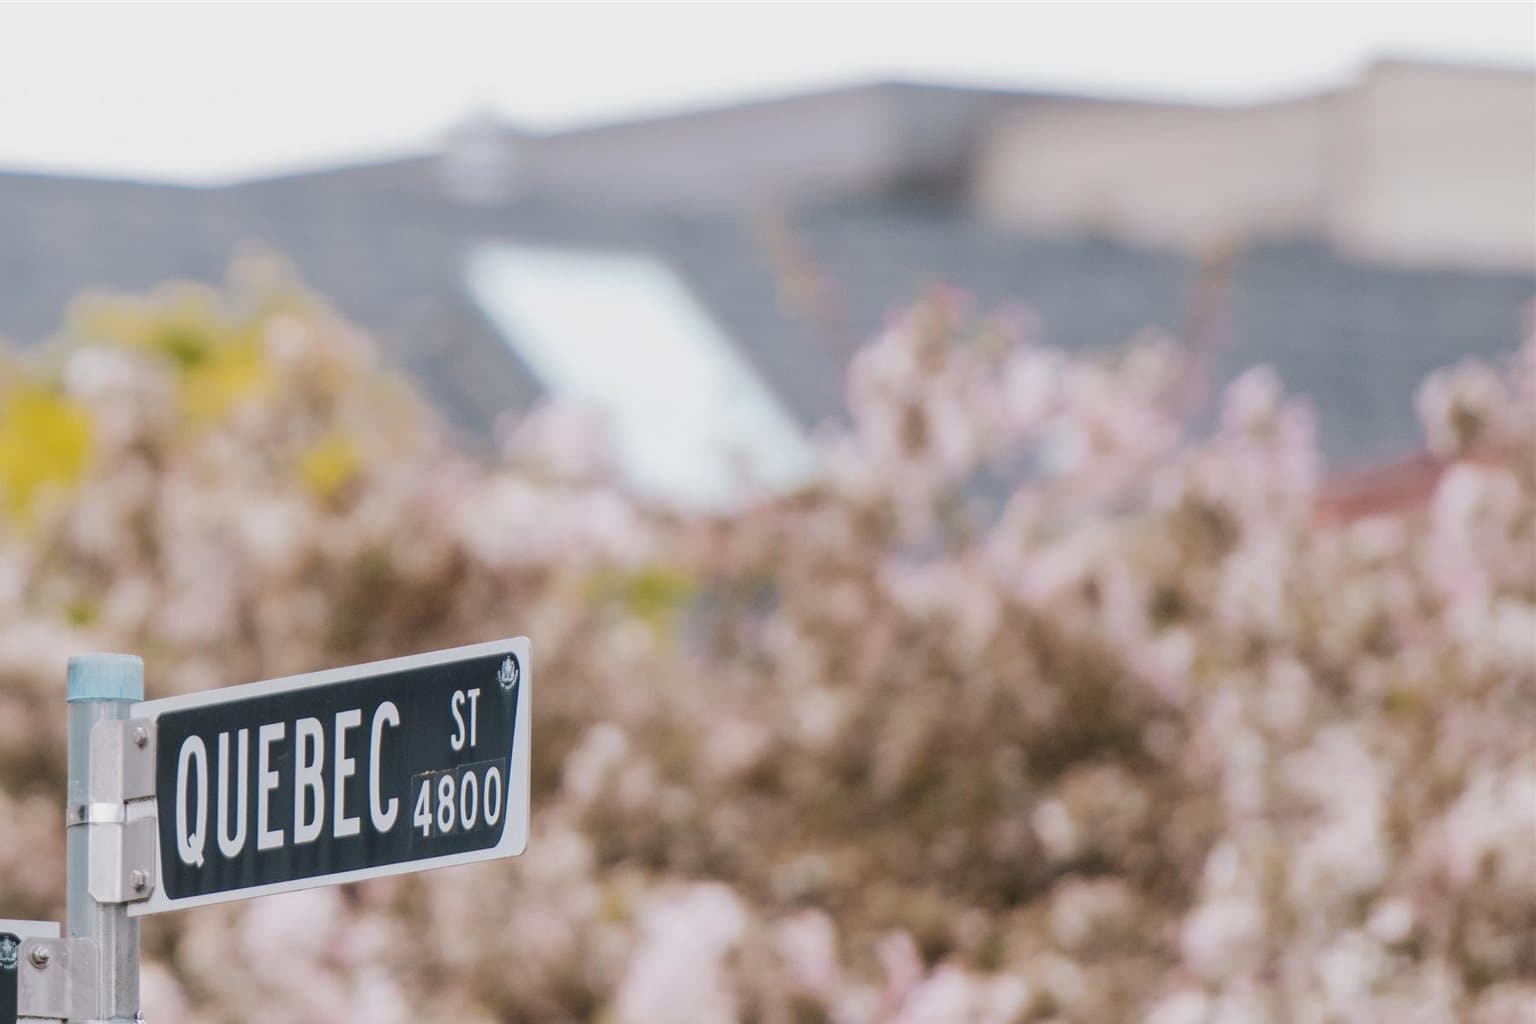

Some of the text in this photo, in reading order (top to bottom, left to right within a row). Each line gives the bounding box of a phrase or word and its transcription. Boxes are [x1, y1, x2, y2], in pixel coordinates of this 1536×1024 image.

[176, 688, 480, 868] QUEBEC ST
[413, 766, 502, 836] 4800
